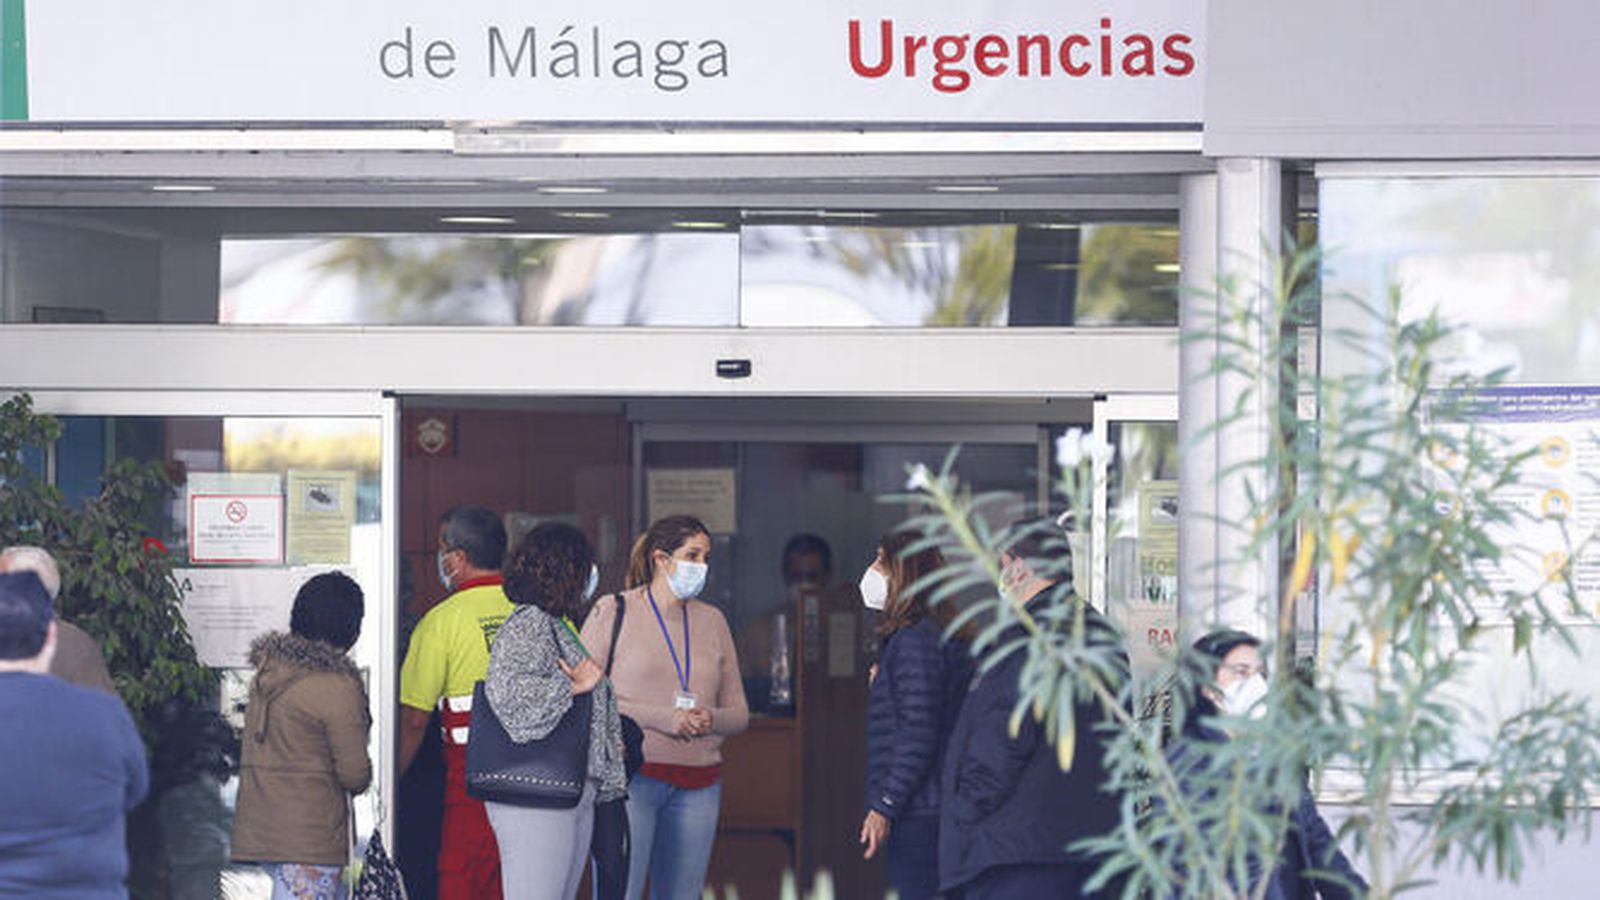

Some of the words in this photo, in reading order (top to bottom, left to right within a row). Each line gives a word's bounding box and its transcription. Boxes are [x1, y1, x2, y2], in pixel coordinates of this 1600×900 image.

[379, 26, 456, 79] de
[488, 25, 730, 92] Málaga
[848, 17, 1196, 93] Urgencias
